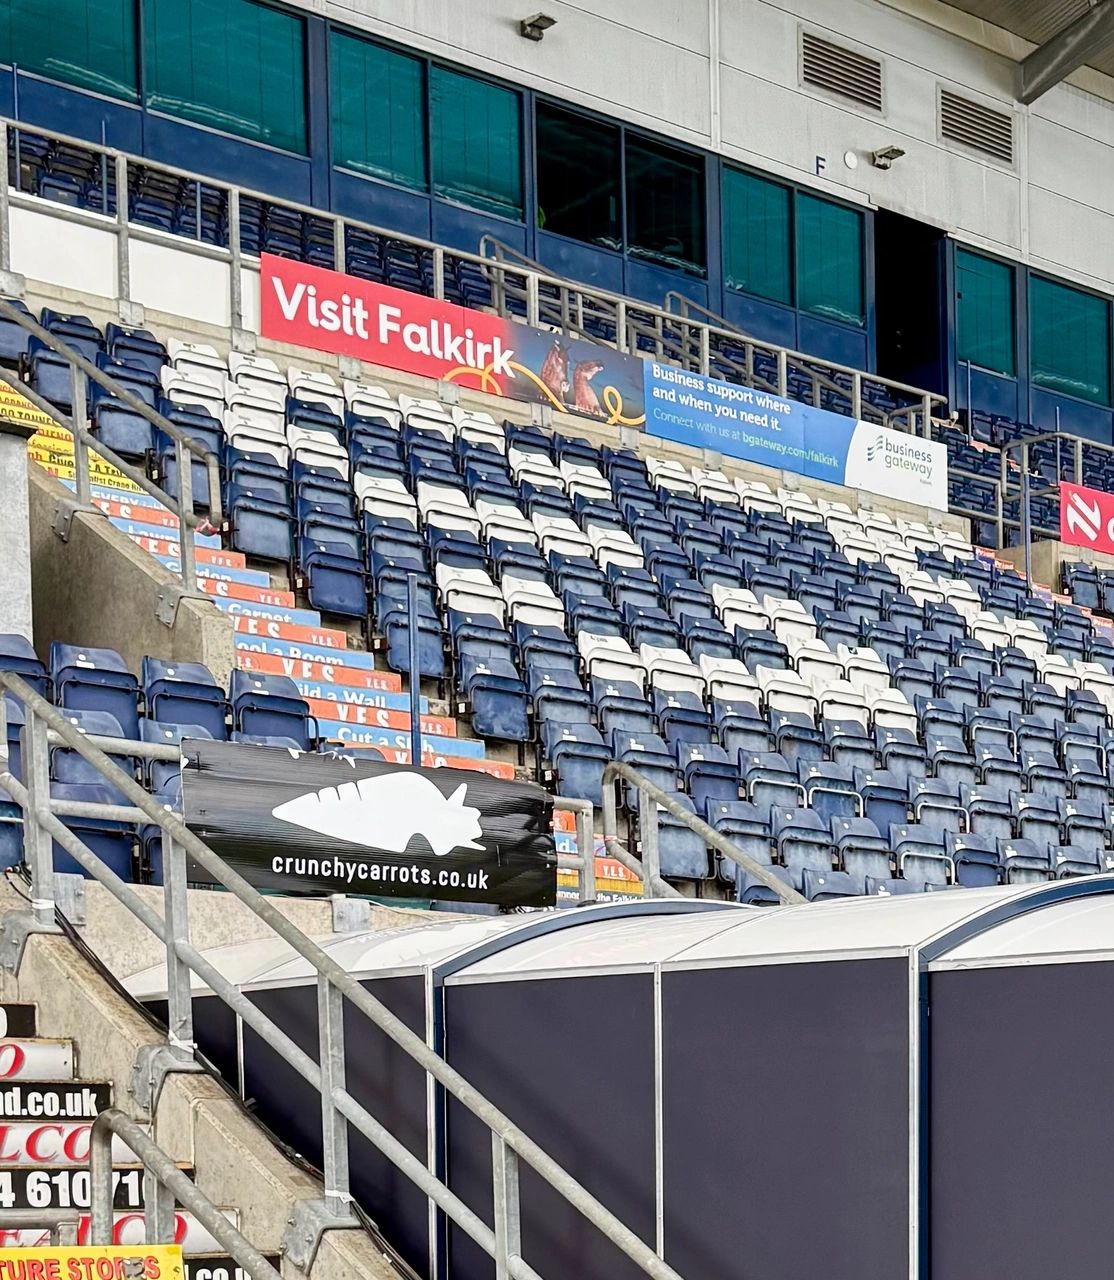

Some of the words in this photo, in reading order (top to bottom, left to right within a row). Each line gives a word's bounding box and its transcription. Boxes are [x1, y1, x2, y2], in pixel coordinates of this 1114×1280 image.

[815, 156, 827, 175] F
[272, 276, 369, 340] Visit
[378, 304, 516, 379] Falkirk
[652, 364, 705, 391] Business
[707, 381, 754, 404] support
[756, 394, 791, 415] where
[653, 386, 676, 400] and
[678, 393, 712, 413] when
[714, 405, 737, 420] you
[740, 410, 768, 428] need
[770, 417, 782, 431] it.
[653, 407, 694, 429] Connect
[695, 420, 717, 434] with
[719, 427, 730, 438] us
[731, 429, 741, 440] at
[742, 431, 839, 469] bgateway.com/falkirk
[885, 437, 932, 463] business
[885, 454, 933, 479] gateway
[271, 856, 489, 890] crunchycarrots.co.uk
